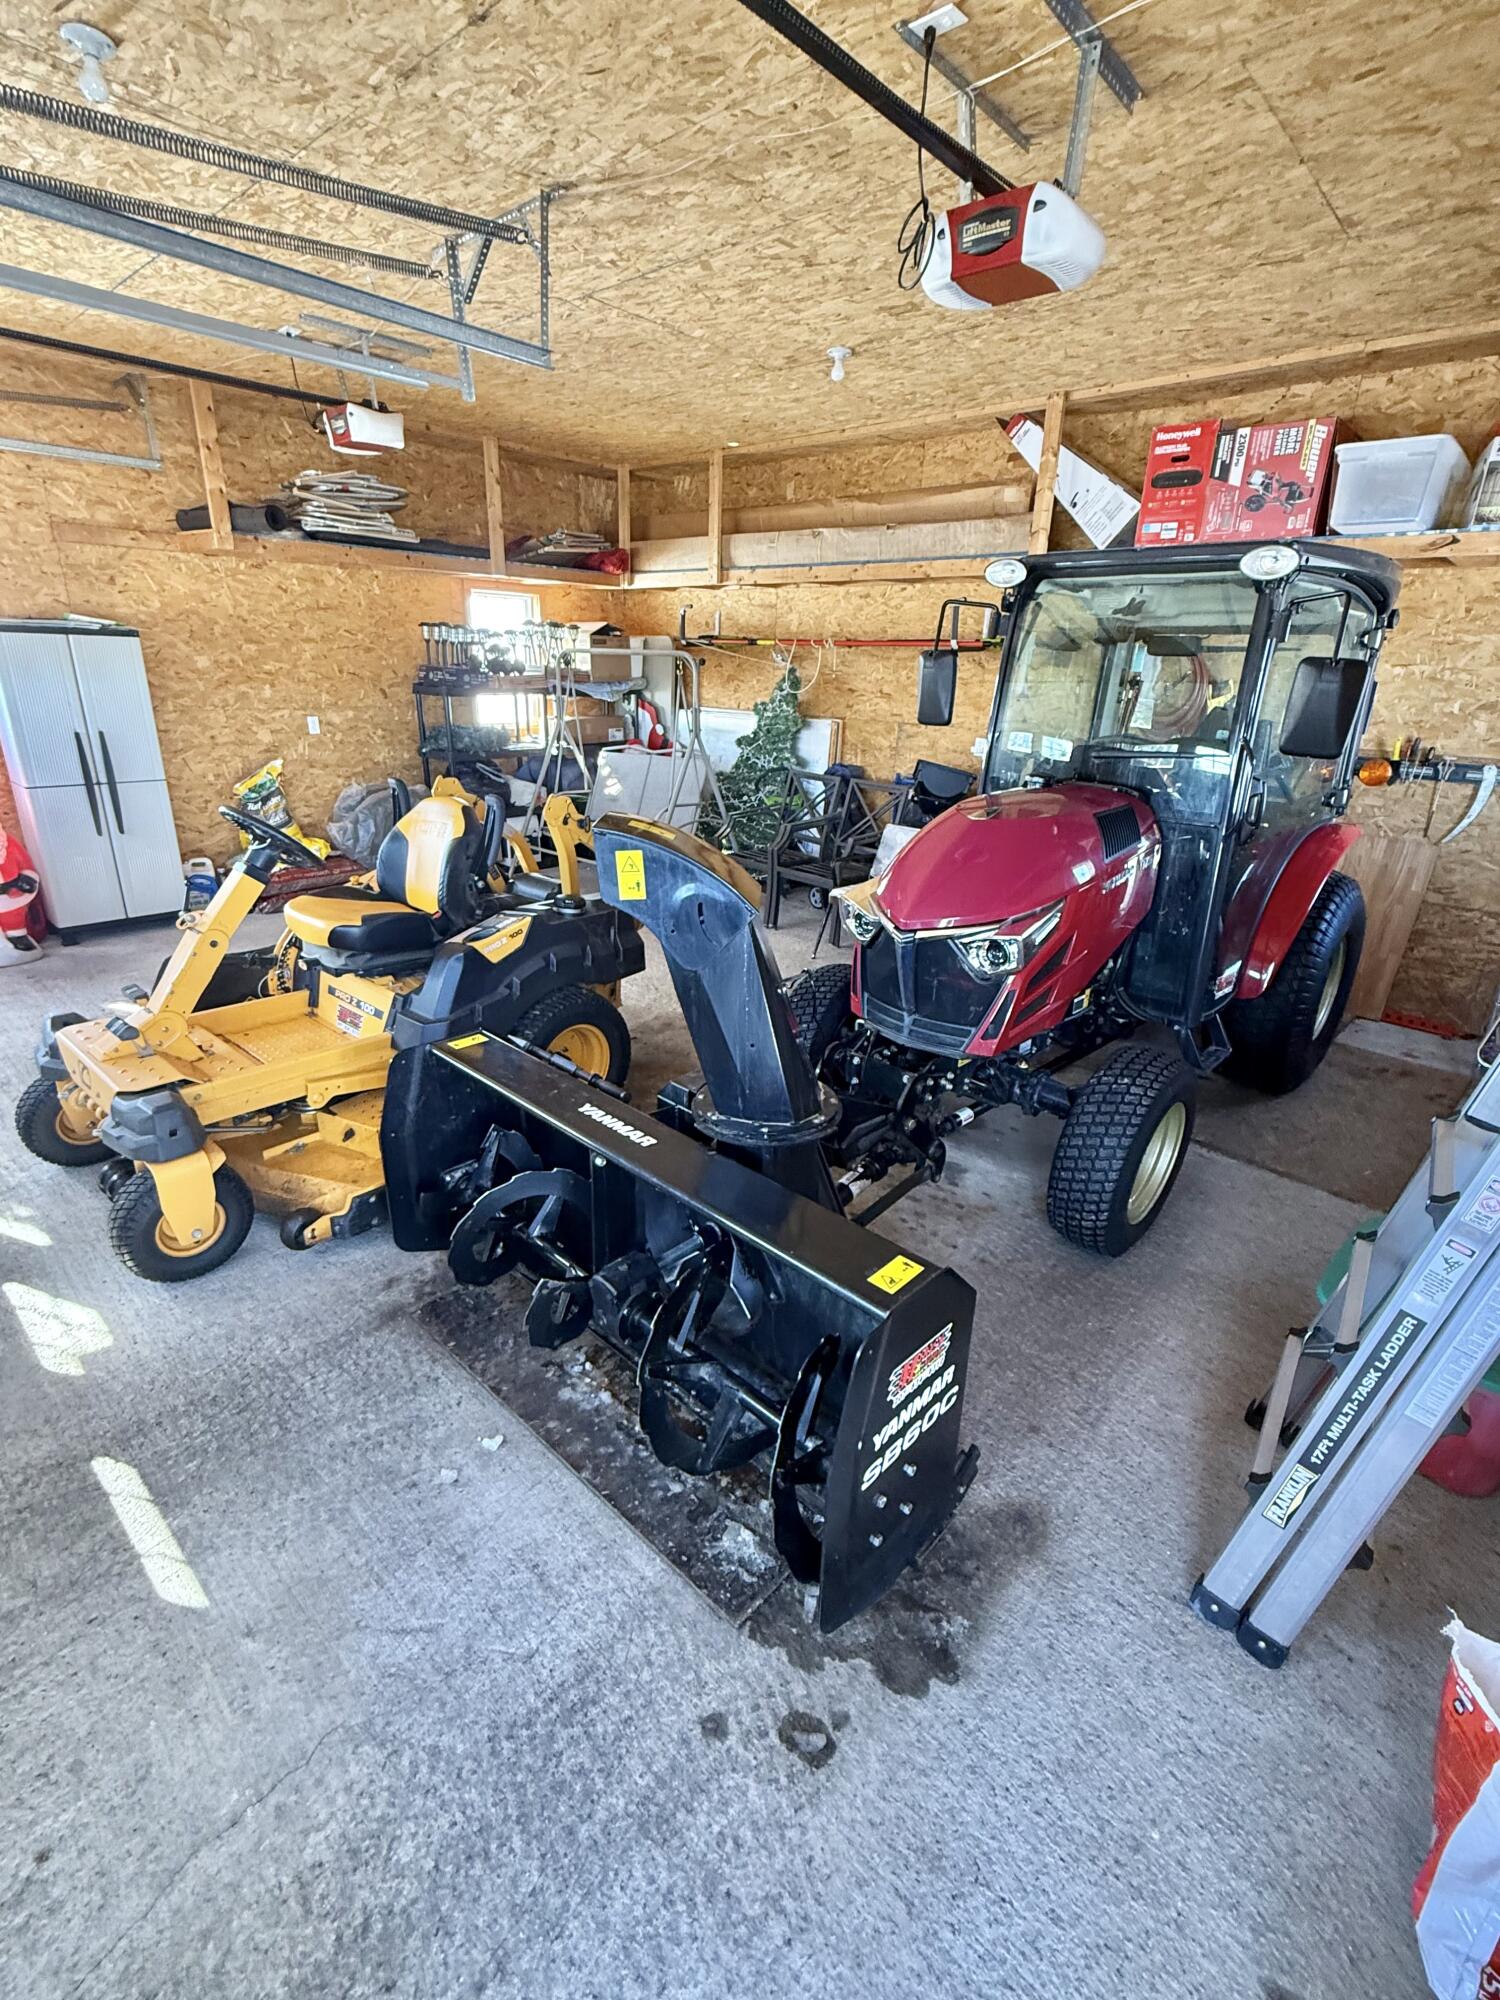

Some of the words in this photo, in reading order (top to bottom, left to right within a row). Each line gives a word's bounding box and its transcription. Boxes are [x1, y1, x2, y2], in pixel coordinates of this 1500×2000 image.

[963, 219, 1011, 237] LiftMaster
[1156, 427, 1201, 441] Honeywell
[1235, 433, 1248, 458] 2300
[1286, 427, 1300, 454] MORE
[1306, 424, 1328, 483] Bauer
[509, 929, 523, 938] 100
[335, 989, 351, 1003] PRO
[351, 997, 358, 1006] Z
[360, 1001, 376, 1015] 100
[578, 1103, 658, 1147] YANMAR
[872, 1365, 956, 1452] YANMAR
[1310, 1435, 1334, 1466] 17Ft
[1328, 1370, 1382, 1442] MULTI-TASK
[1379, 1316, 1418, 1369] LADDER
[861, 1385, 959, 1491] SB60C
[1266, 1467, 1317, 1527] FRANKLIN
